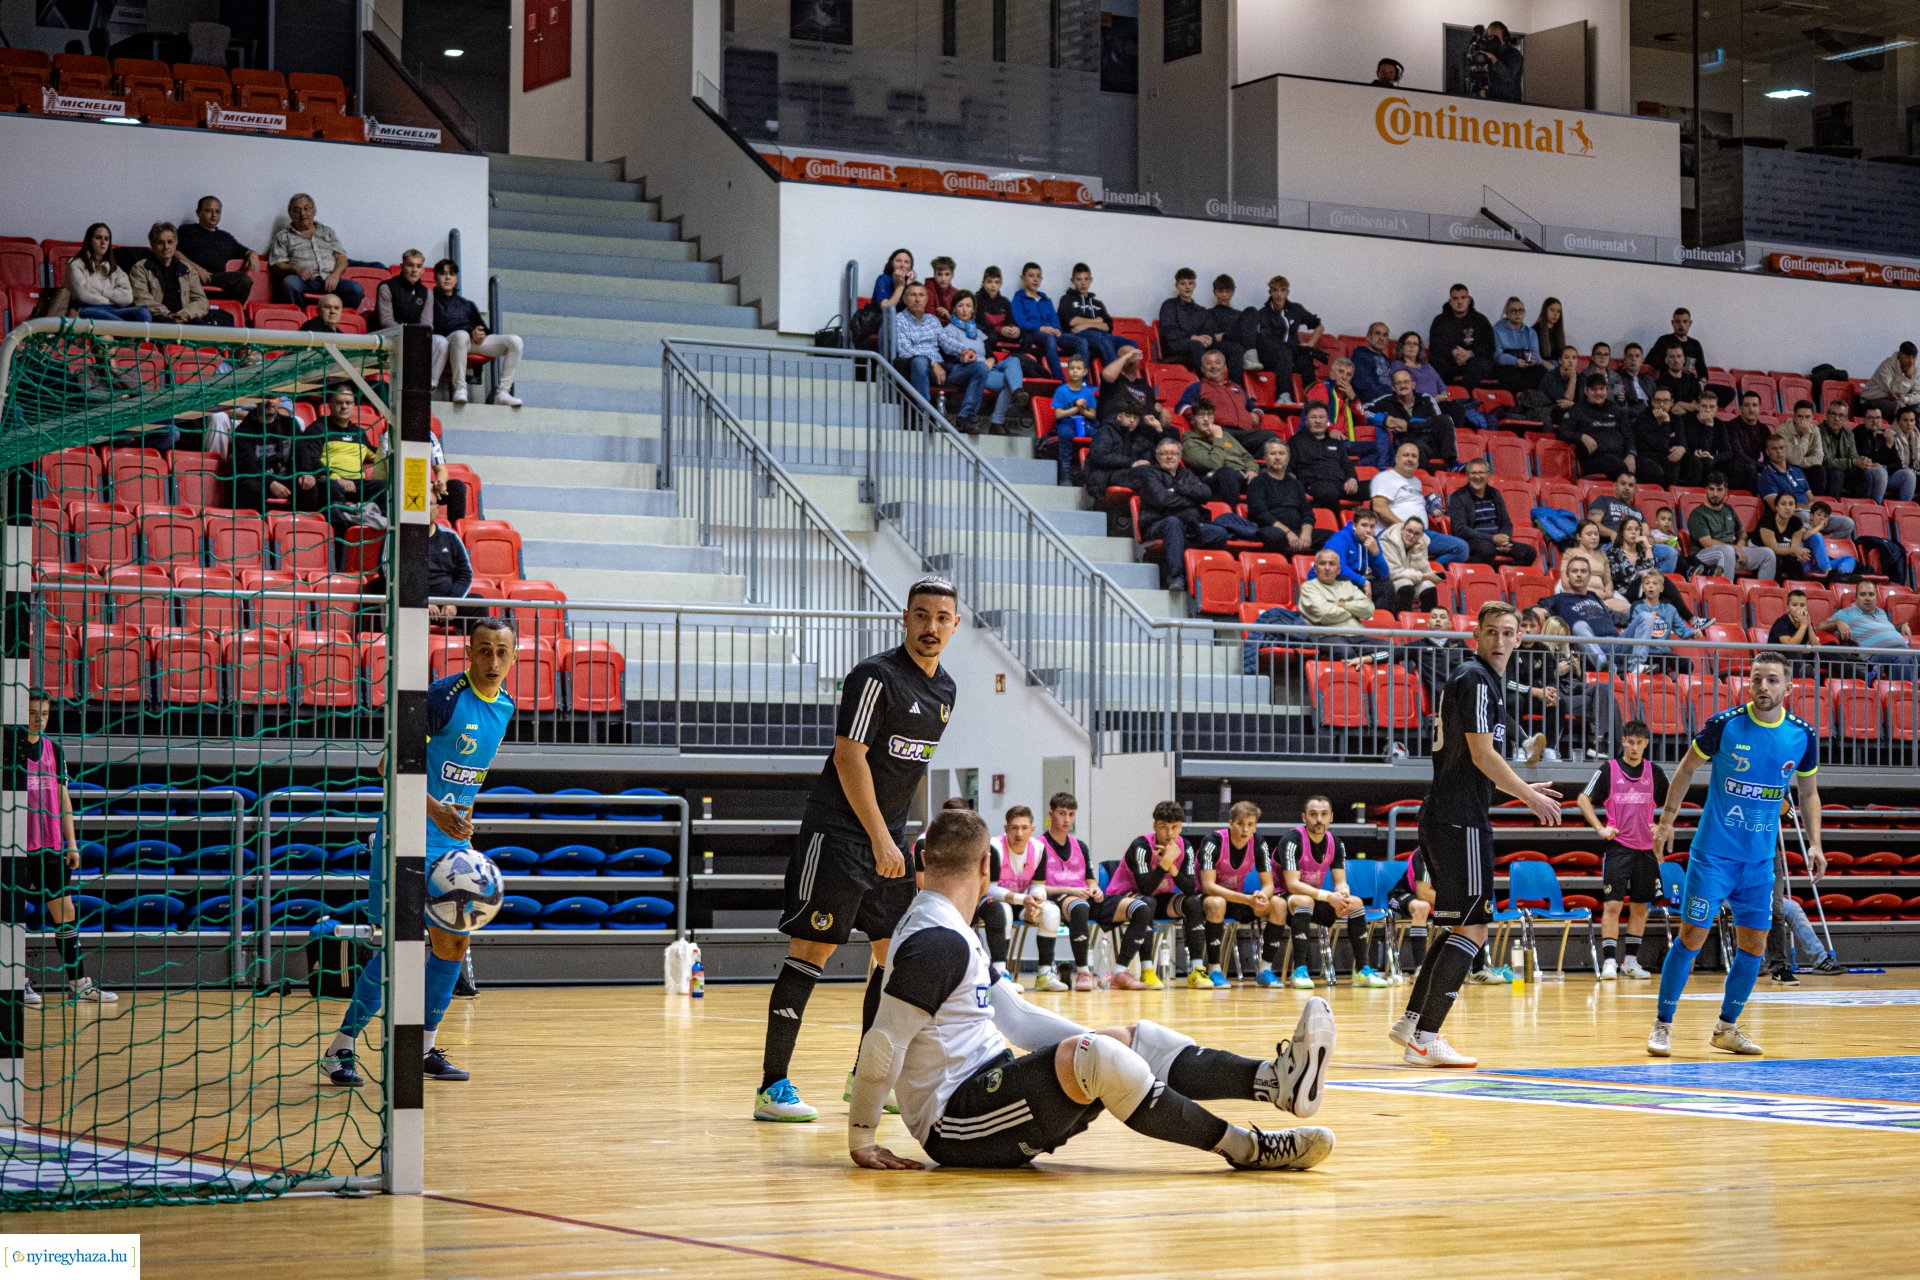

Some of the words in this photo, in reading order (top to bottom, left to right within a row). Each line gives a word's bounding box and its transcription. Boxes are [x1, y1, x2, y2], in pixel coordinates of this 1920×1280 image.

[59, 99, 122, 112] MICHELIN
[223, 113, 283, 126] MICHELIN
[1375, 96, 1565, 154] Continental
[379, 127, 438, 140] MICHELIN
[806, 159, 885, 181] Continental
[943, 172, 1021, 193] Continental
[1330, 210, 1399, 231] Continental
[1449, 222, 1515, 242] Continental
[1564, 233, 1628, 253] Continental
[1673, 245, 1735, 264] Continental
[1779, 255, 1839, 274] Continental
[465, 723, 479, 731] JAKO
[1735, 743, 1751, 751] JAKO
